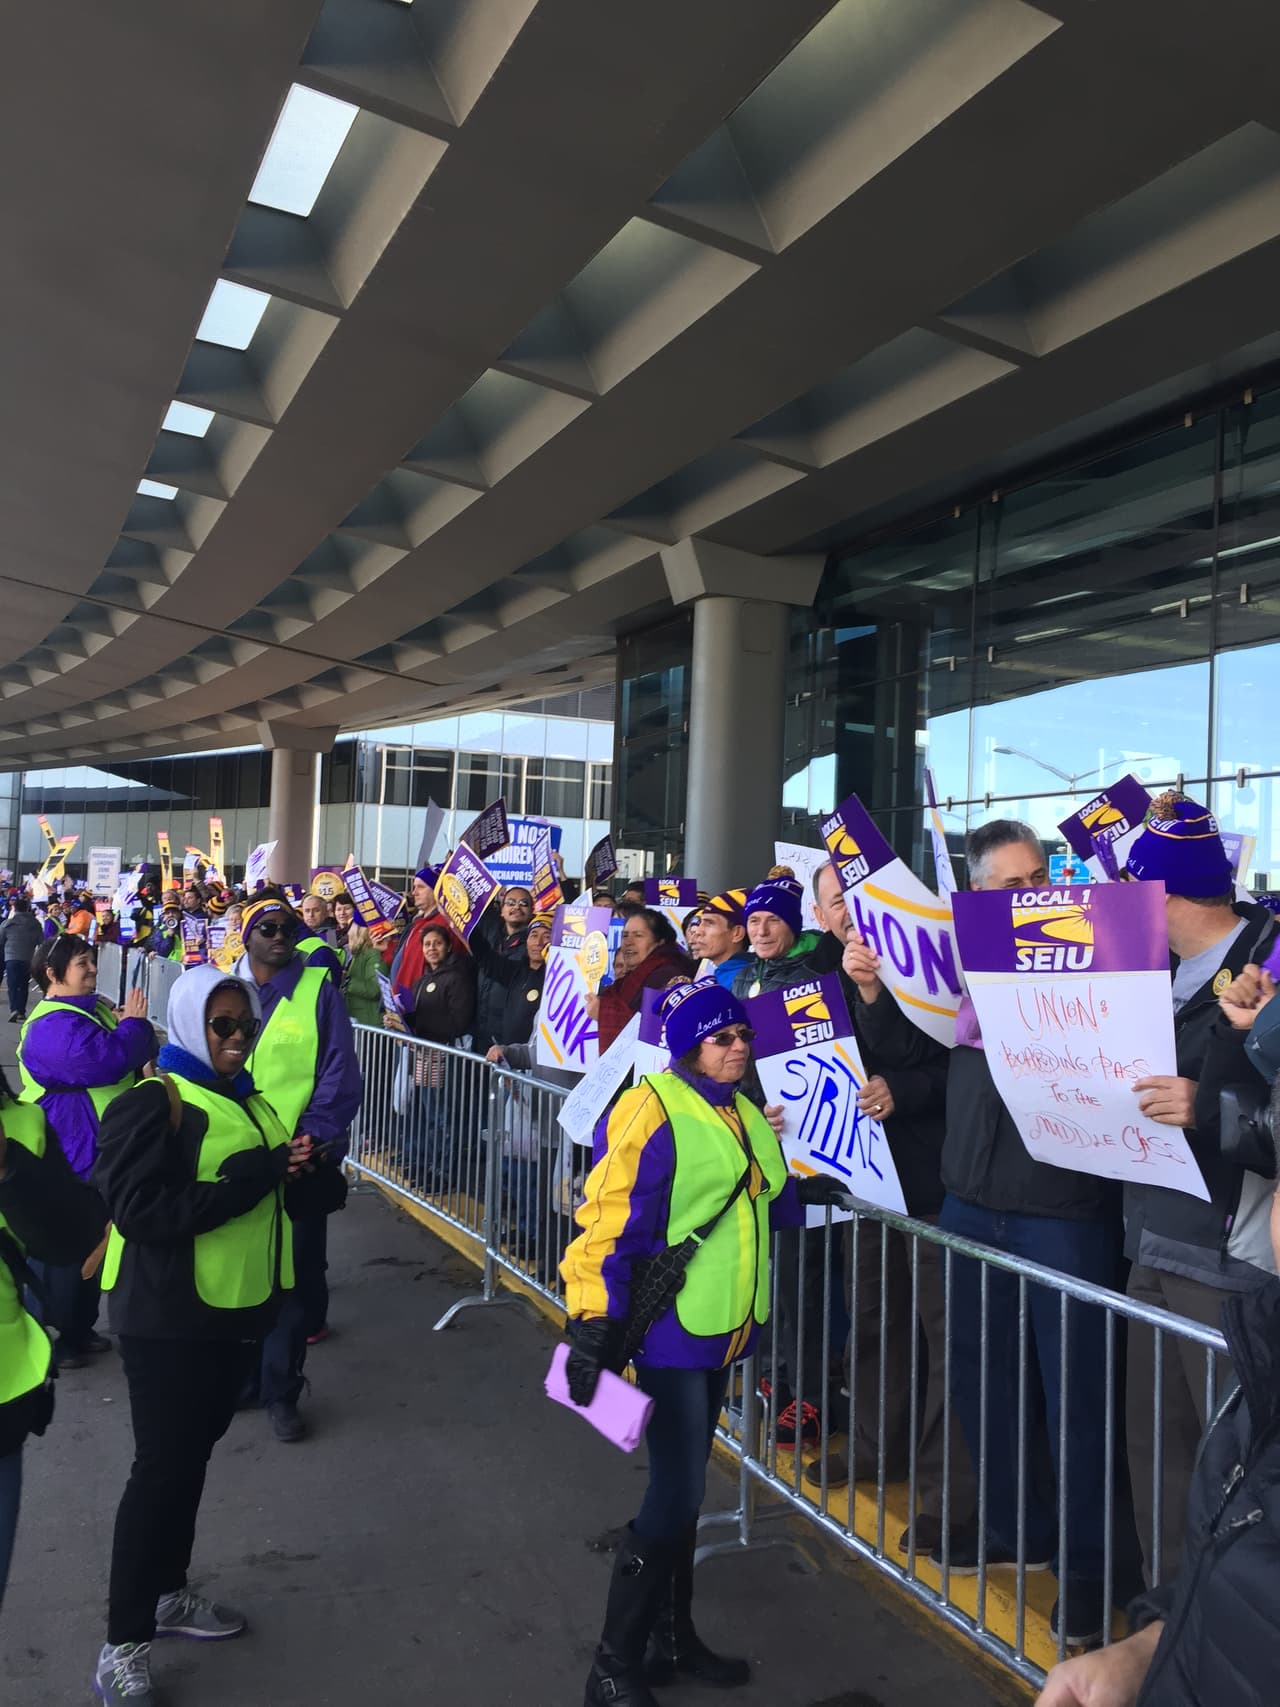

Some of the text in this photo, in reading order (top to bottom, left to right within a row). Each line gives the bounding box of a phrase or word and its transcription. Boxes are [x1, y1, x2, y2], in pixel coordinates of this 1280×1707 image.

[1078, 797, 1102, 820] LOCAL
[821, 814, 840, 837] LOCAL
[456, 864, 472, 881] FAST
[468, 879, 484, 896] FOOD
[458, 854, 492, 893] AIRPORT AND
[841, 854, 870, 887] SEIU
[659, 897, 680, 906] SEIU
[1011, 888, 1091, 908] LOCAL 1
[1015, 945, 1095, 972] SEIU
[668, 979, 715, 1007] SEIU
[783, 981, 817, 1002] LOCAL
[545, 951, 598, 1064] HONK
[695, 1012, 723, 1038] Local
[794, 1020, 834, 1047] SEIU
[1091, 1047, 1151, 1080] PASS
[780, 1052, 884, 1181] STRIKE
